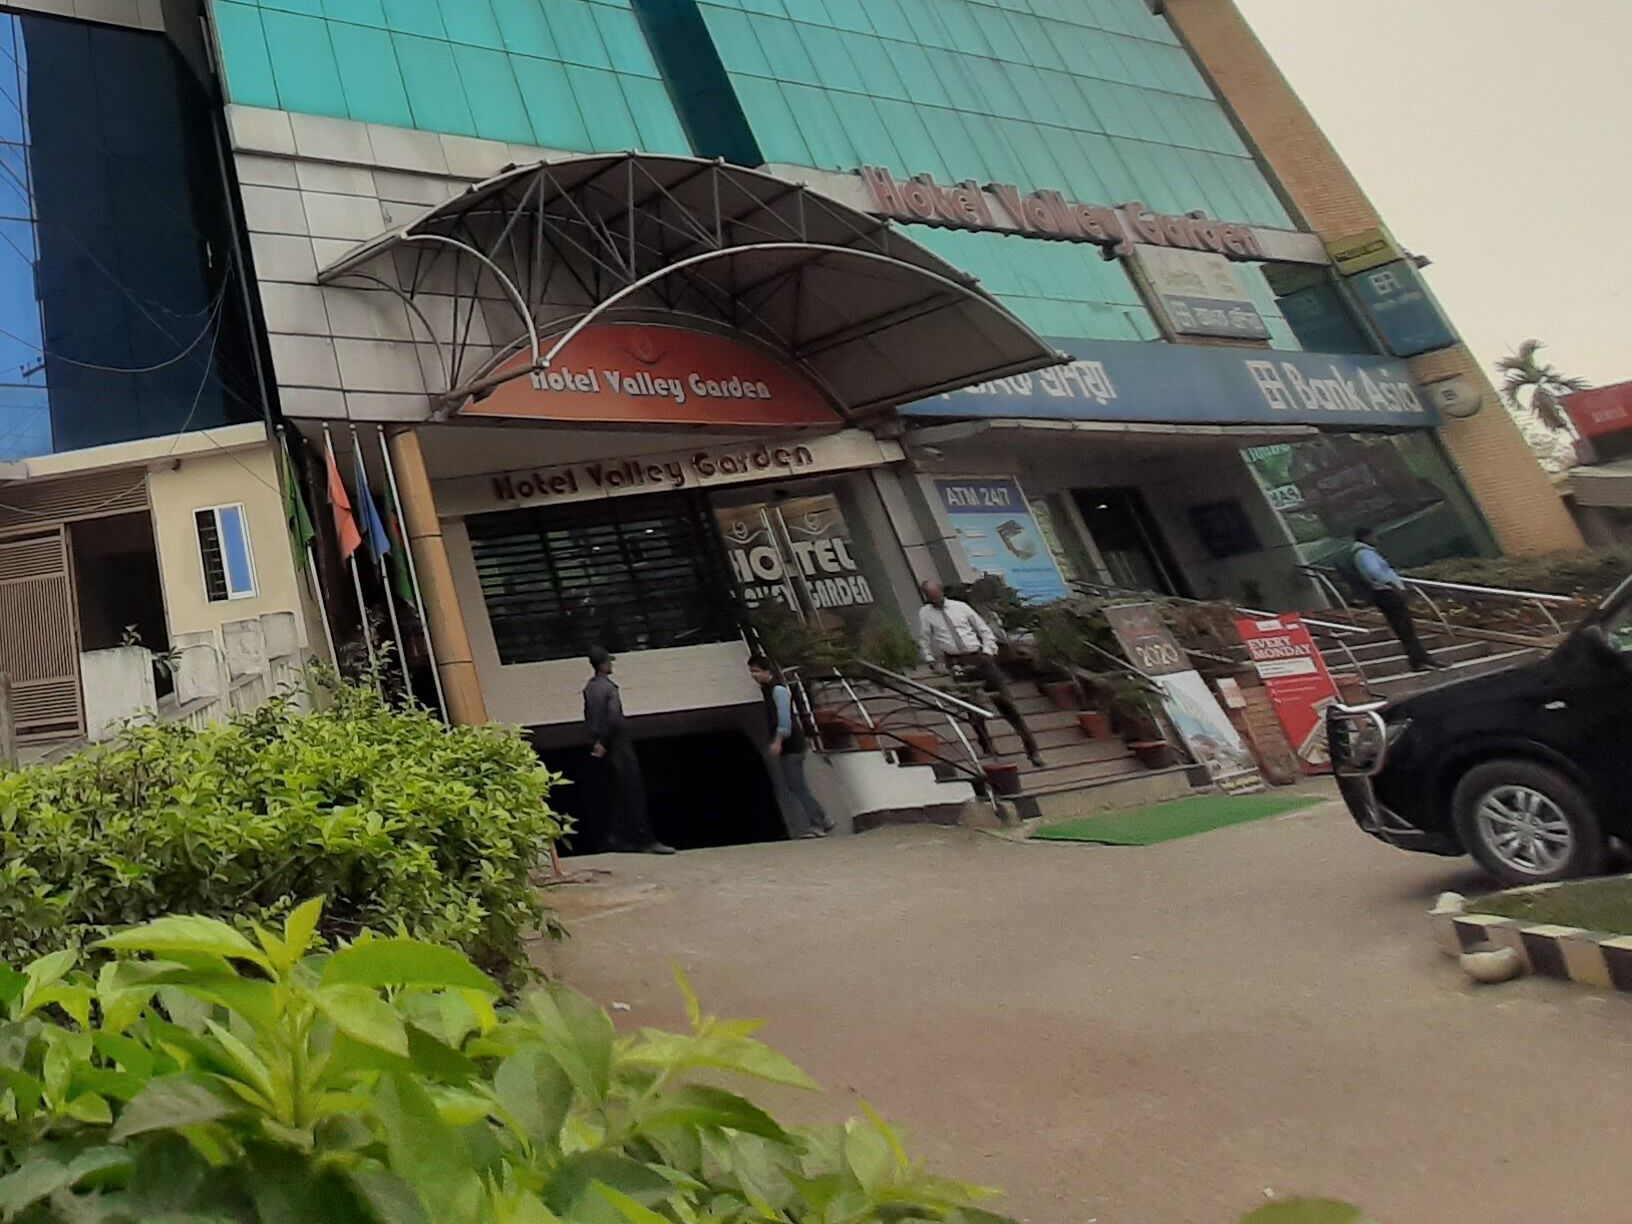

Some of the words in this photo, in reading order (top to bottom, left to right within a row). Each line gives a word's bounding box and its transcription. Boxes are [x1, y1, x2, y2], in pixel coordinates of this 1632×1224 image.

[863, 166, 994, 227] Hotel
[988, 183, 1134, 257] Valley
[1118, 202, 1264, 257] Garden
[531, 367, 600, 392] Hotel
[604, 370, 685, 404] Valley
[689, 373, 771, 399] Garden
[1281, 362, 1370, 411] Bank
[1357, 366, 1424, 412] Asia
[492, 468, 578, 500] Hotel
[586, 461, 687, 487] Valley
[691, 443, 815, 477] Garden
[945, 487, 980, 506] ATM
[728, 538, 857, 583] HOTEL
[1135, 643, 1179, 667] 2020
[1248, 636, 1290, 649] EVERY
[1253, 644, 1311, 660] MONDAY
